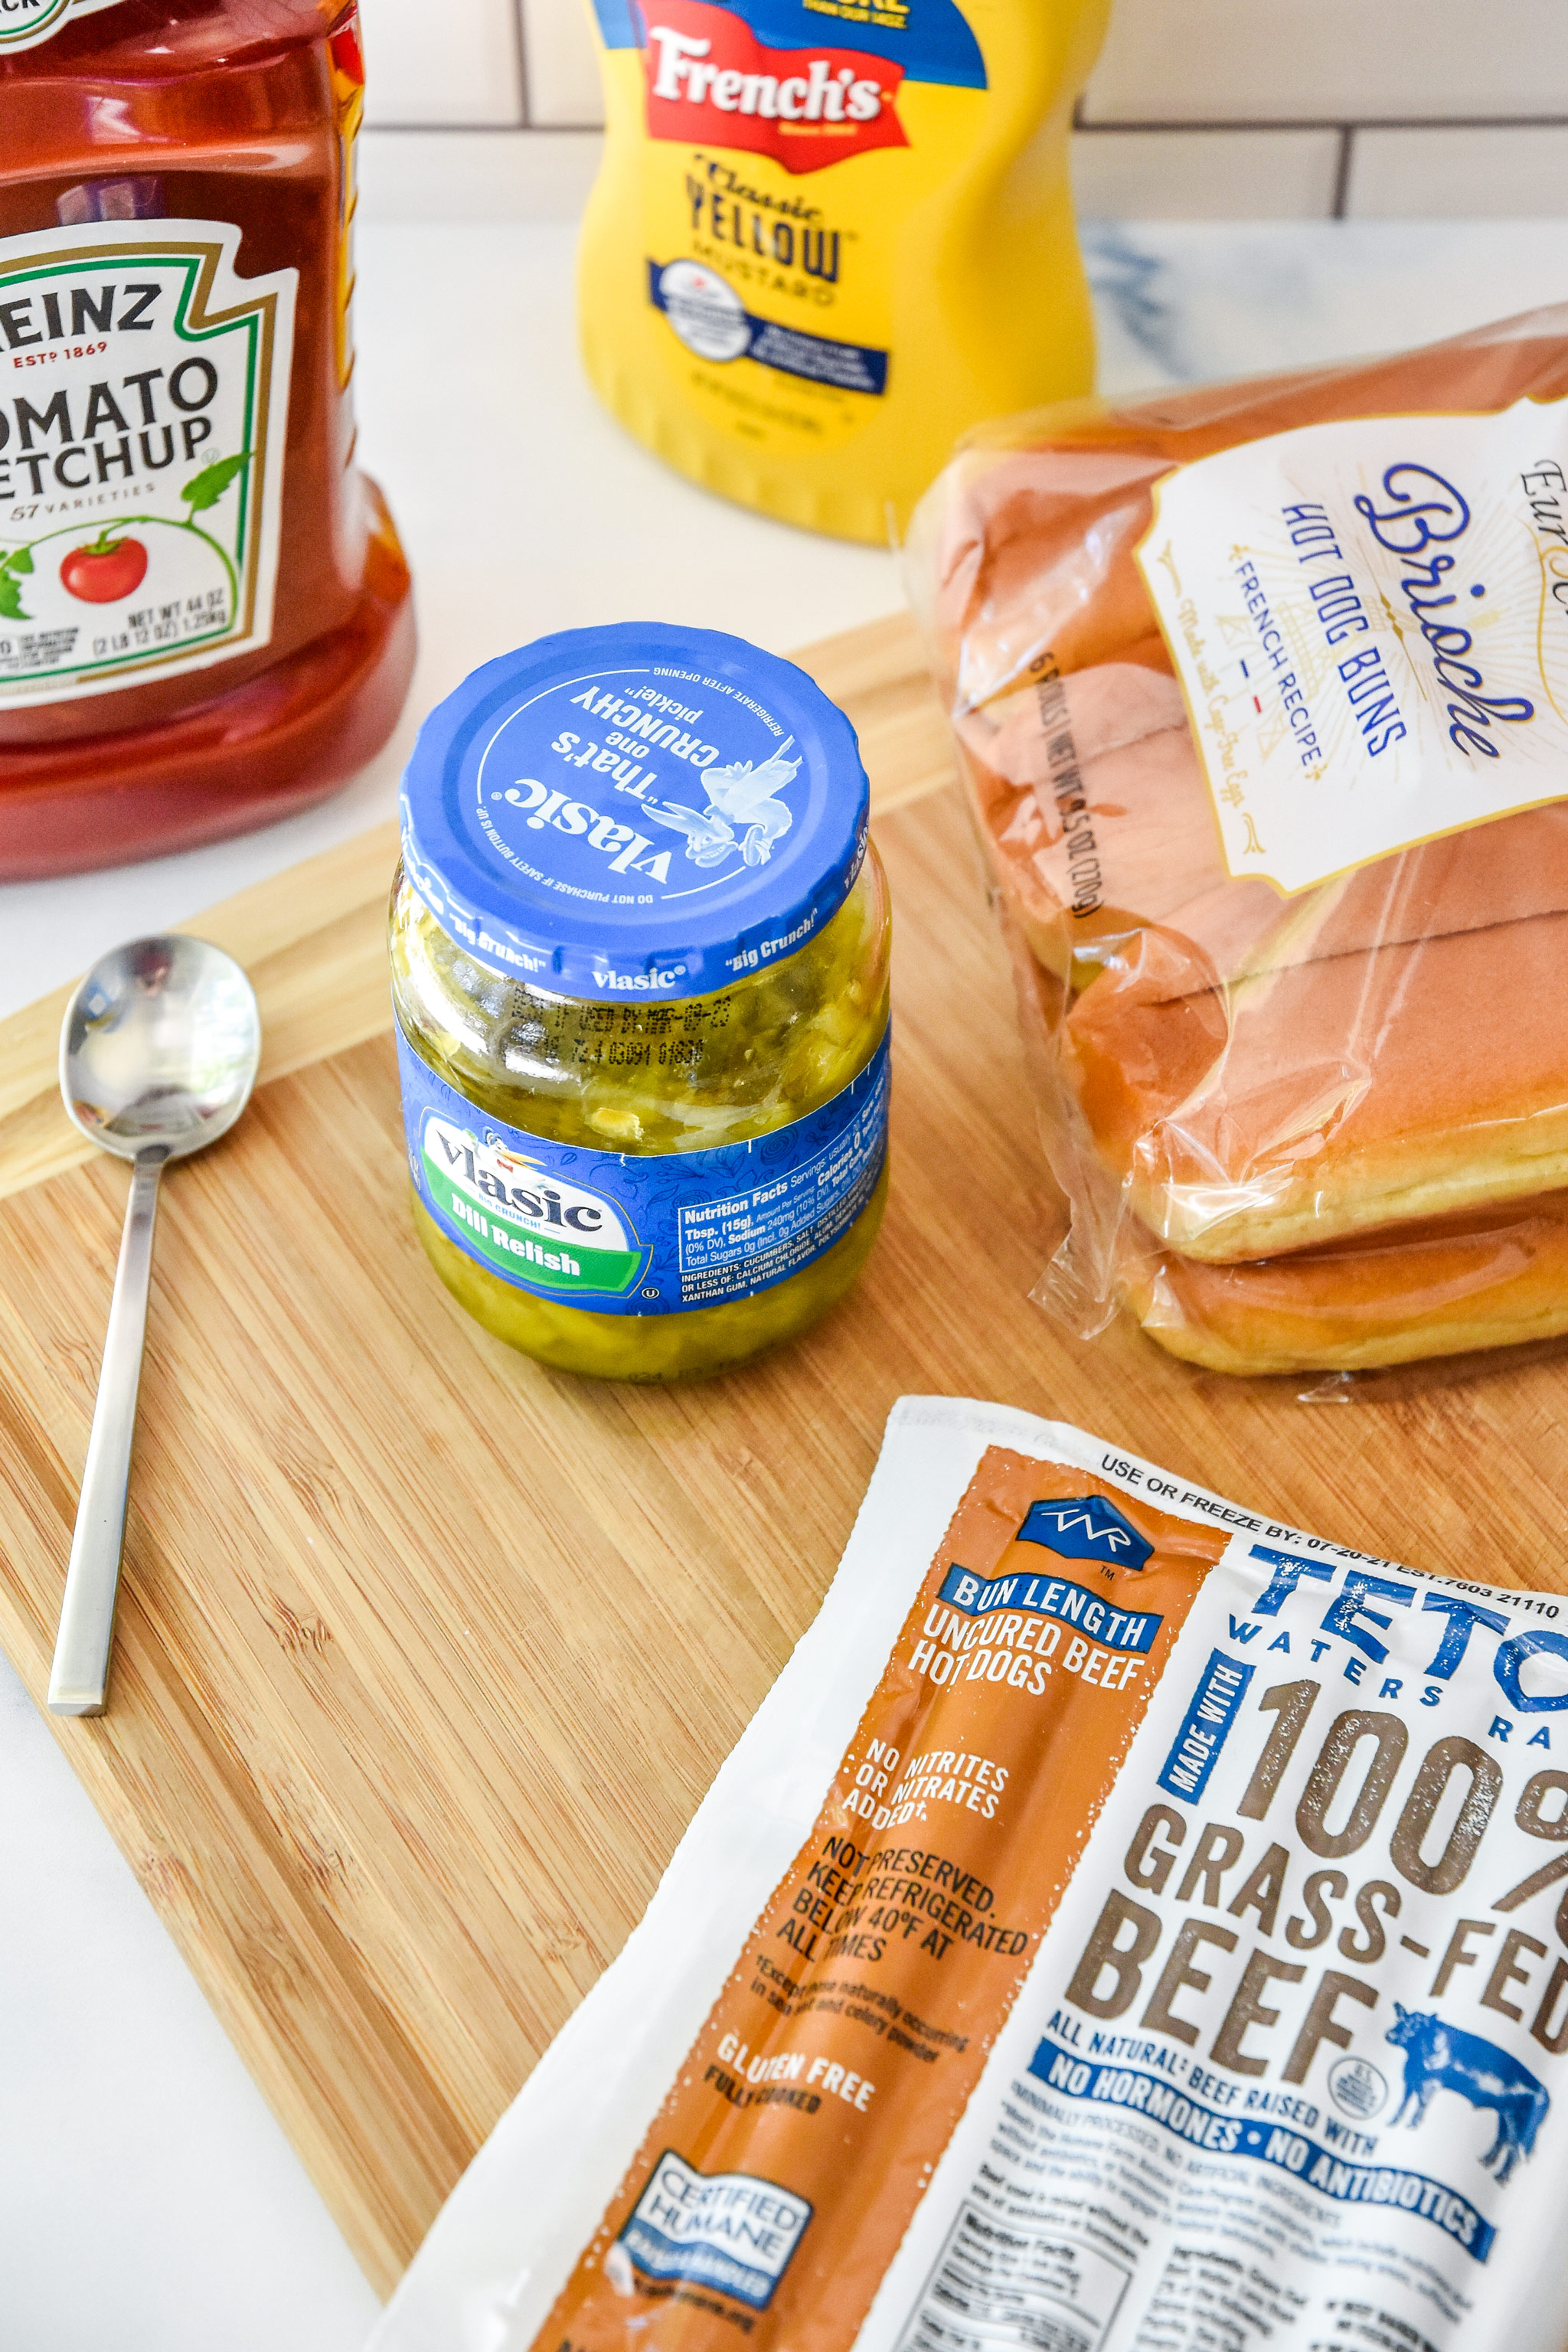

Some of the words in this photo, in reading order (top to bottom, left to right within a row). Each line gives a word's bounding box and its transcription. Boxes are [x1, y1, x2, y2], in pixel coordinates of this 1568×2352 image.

[649, 26, 881, 121] French's
[694, 153, 822, 222] Classic
[685, 173, 841, 284] YELLOW
[693, 240, 835, 308] MUSTARD
[0, 283, 162, 354] EINZ
[64, 341, 107, 360] 1869
[0, 357, 218, 452] MATO
[11, 505, 39, 521] 57
[45, 482, 156, 515] VARIETIES
[1282, 502, 1344, 565] HOT
[129, 609, 153, 629] NET
[160, 601, 181, 619] WT
[1308, 573, 1367, 646] DOG
[1353, 462, 1534, 760] Brioche
[653, 666, 701, 685] OPENING
[702, 676, 735, 695] AFTER
[1234, 560, 1291, 672] FRENCH
[1278, 671, 1324, 768] RECIPE
[570, 685, 720, 768] CRUNCHY
[733, 690, 786, 737] REFRIGERATE
[1176, 599, 1208, 659] Made
[1196, 659, 1220, 691] with
[1220, 769, 1251, 807] Eggs
[1337, 645, 1407, 759] BUNS
[605, 730, 651, 760] one
[475, 805, 488, 819] UP.
[480, 817, 490, 829] IS
[485, 828, 514, 861] BUTTON
[511, 858, 545, 884] SAFETY
[544, 877, 555, 887] IF
[553, 880, 609, 903] PURCHASE
[611, 893, 635, 905] NOT
[637, 893, 655, 905] DO
[478, 1192, 495, 1209] BIG
[495, 1204, 541, 1230] CRUNCH!
[684, 1227, 719, 1241] Tbsp.
[756, 1205, 781, 1223] Amount
[781, 1199, 792, 1210] Per
[817, 1147, 854, 1187] Calories
[854, 1131, 861, 1150] 0
[684, 1199, 749, 1225] Nutrition
[752, 1181, 788, 1207] Facts
[685, 1244, 704, 1256] (0%
[728, 1224, 766, 1245] Sodium
[767, 1209, 795, 1230] 240mg
[795, 1197, 815, 1217] (10%
[831, 1167, 849, 1187] Total
[451, 1192, 488, 1238] Dill
[490, 1224, 581, 1277] Relish
[686, 1253, 708, 1267] Total
[710, 1246, 743, 1263] Sugars
[743, 1241, 756, 1253] 0g
[756, 1234, 776, 1250] (Incl.
[778, 1226, 789, 1238] 0g
[790, 1208, 815, 1232] Added
[681, 1263, 742, 1284] INGREDIENTS:
[681, 1283, 694, 1294] OR
[697, 1277, 719, 1291] LESS
[720, 1273, 735, 1285] OF:
[736, 1259, 774, 1281] CALCIUM
[682, 1285, 725, 1303] XANTHAN
[750, 1265, 787, 1286] NATURAL
[1101, 1452, 1145, 1486] USE
[1146, 1477, 1179, 1501] OR
[1181, 1491, 1262, 1531] FREEZE
[1265, 1524, 1303, 1546] BY:
[1307, 1537, 1390, 1568] 07-20-21
[1497, 1591, 1560, 1619] 21110
[953, 1574, 1015, 1612] BUN
[1022, 1579, 1148, 1647] LENGTH
[907, 1639, 972, 1686] HOT
[965, 1648, 1053, 1696] DOGS
[923, 1603, 1062, 1657] UNCURED
[1062, 1633, 1145, 1690] BEEF
[1227, 1613, 1445, 1707] WATERS
[1168, 1721, 1219, 1795] MADE
[1196, 1663, 1245, 1727] WITH
[855, 1762, 889, 1798] OR
[890, 1775, 1000, 1820] NITRATES
[865, 1737, 901, 1772] NO
[903, 1750, 1010, 1793] NITRITES
[806, 1859, 863, 1907] KEEP
[864, 1876, 1029, 1958] REFRIGERATED
[822, 1835, 871, 1878] NOT
[867, 1847, 997, 1920] PRESERVED.
[776, 1917, 816, 1964] ALL
[792, 1886, 865, 1937] BELOW
[867, 1905, 925, 1940] 40°F
[920, 1929, 955, 1962] AT
[1123, 1803, 1568, 2056] GRASS-FED
[1064, 1888, 1380, 2086] BEEF
[704, 2064, 754, 2108] FULLY
[717, 2033, 806, 2085] GLUTEN
[806, 2056, 876, 2112] FREE
[1047, 2009, 1081, 2047] ALL
[1187, 2063, 1242, 2112] BEEF
[1243, 2088, 1320, 2134] RAISED
[1321, 2120, 1380, 2161] WITH
[1048, 2053, 1090, 2096] NO
[1091, 2060, 1245, 2154] HORMONES
[1263, 2128, 1310, 2173] NO
[1308, 2153, 1483, 2246] ANTIBIOTICS
[649, 2193, 783, 2260] HUMANE
[662, 2170, 799, 2231] CERTIFIED
